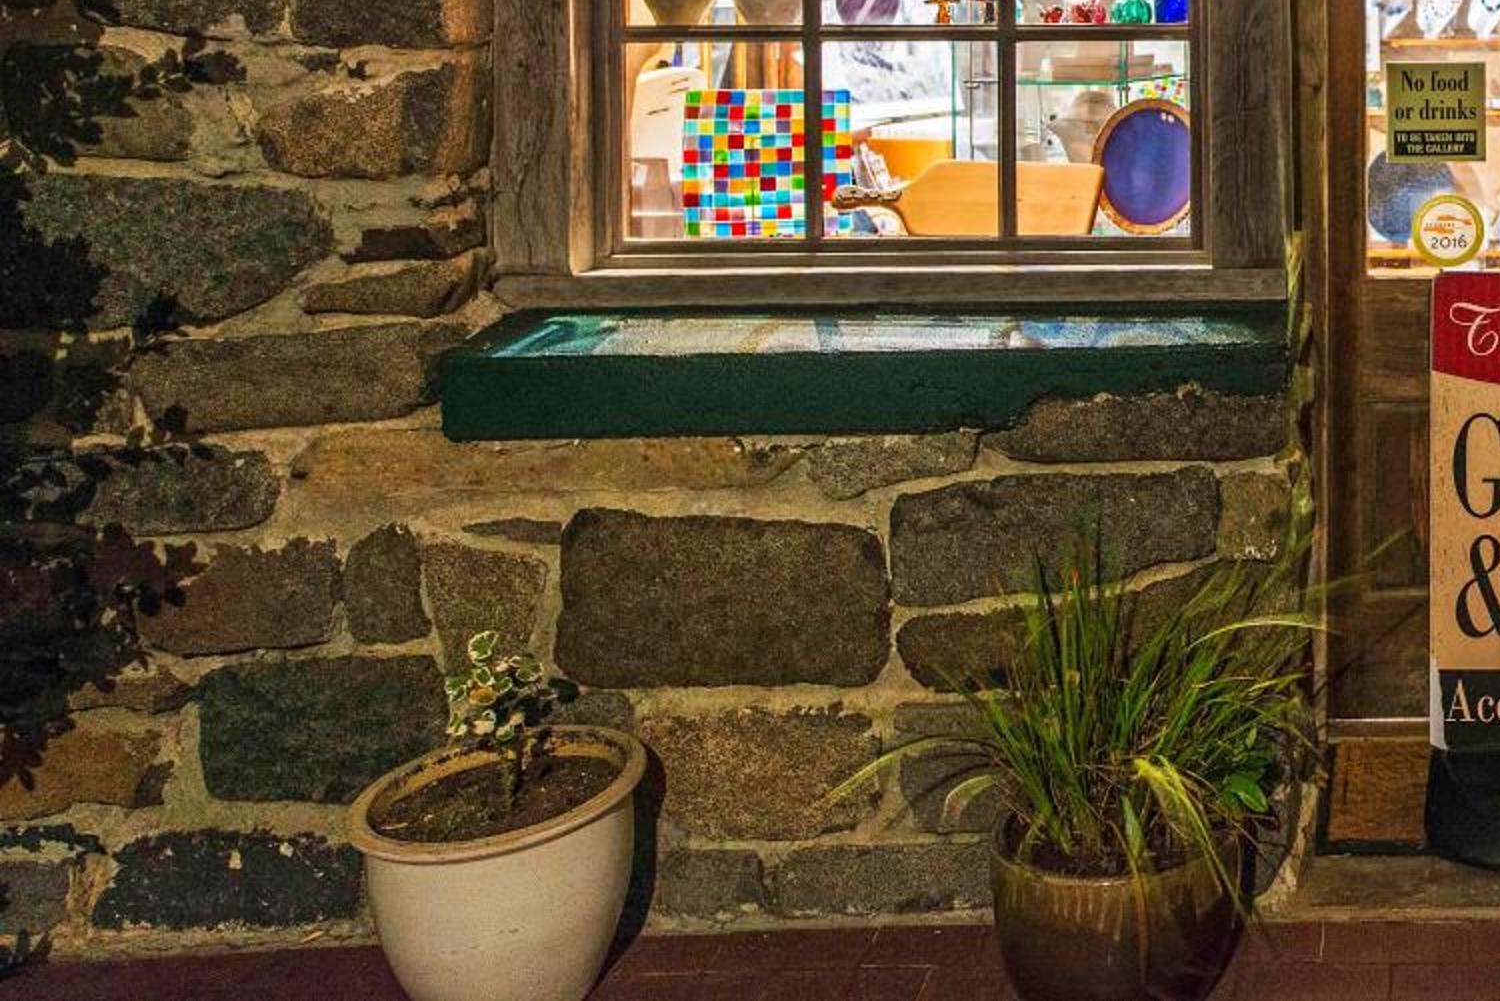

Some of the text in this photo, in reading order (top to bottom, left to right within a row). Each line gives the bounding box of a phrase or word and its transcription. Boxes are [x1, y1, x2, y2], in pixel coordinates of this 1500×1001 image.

[1401, 70, 1469, 92] No food
[1394, 98, 1477, 120] or drinks
[1431, 234, 1467, 249] 2016
